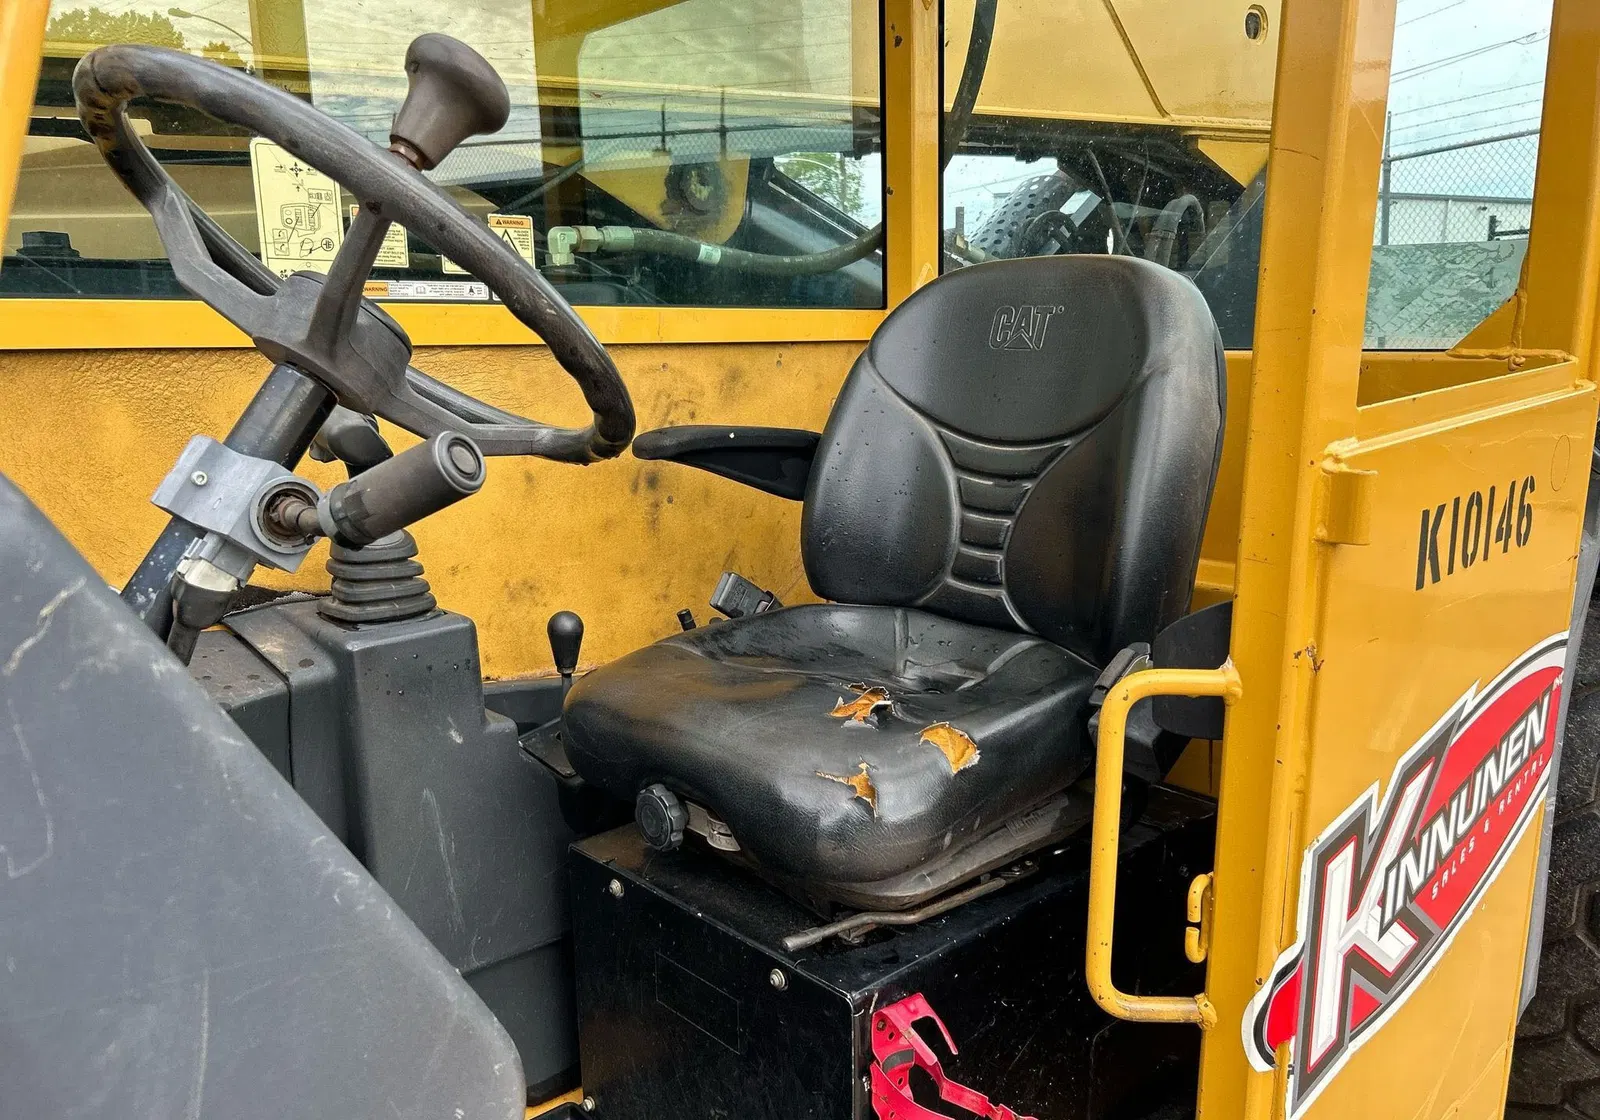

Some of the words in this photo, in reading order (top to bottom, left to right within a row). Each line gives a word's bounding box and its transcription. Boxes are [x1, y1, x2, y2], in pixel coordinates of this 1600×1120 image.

[989, 305, 1056, 351] CAT
[1415, 475, 1536, 591] K10146
[1431, 836, 1476, 901] SALES
[1498, 757, 1544, 816] RENTAL
